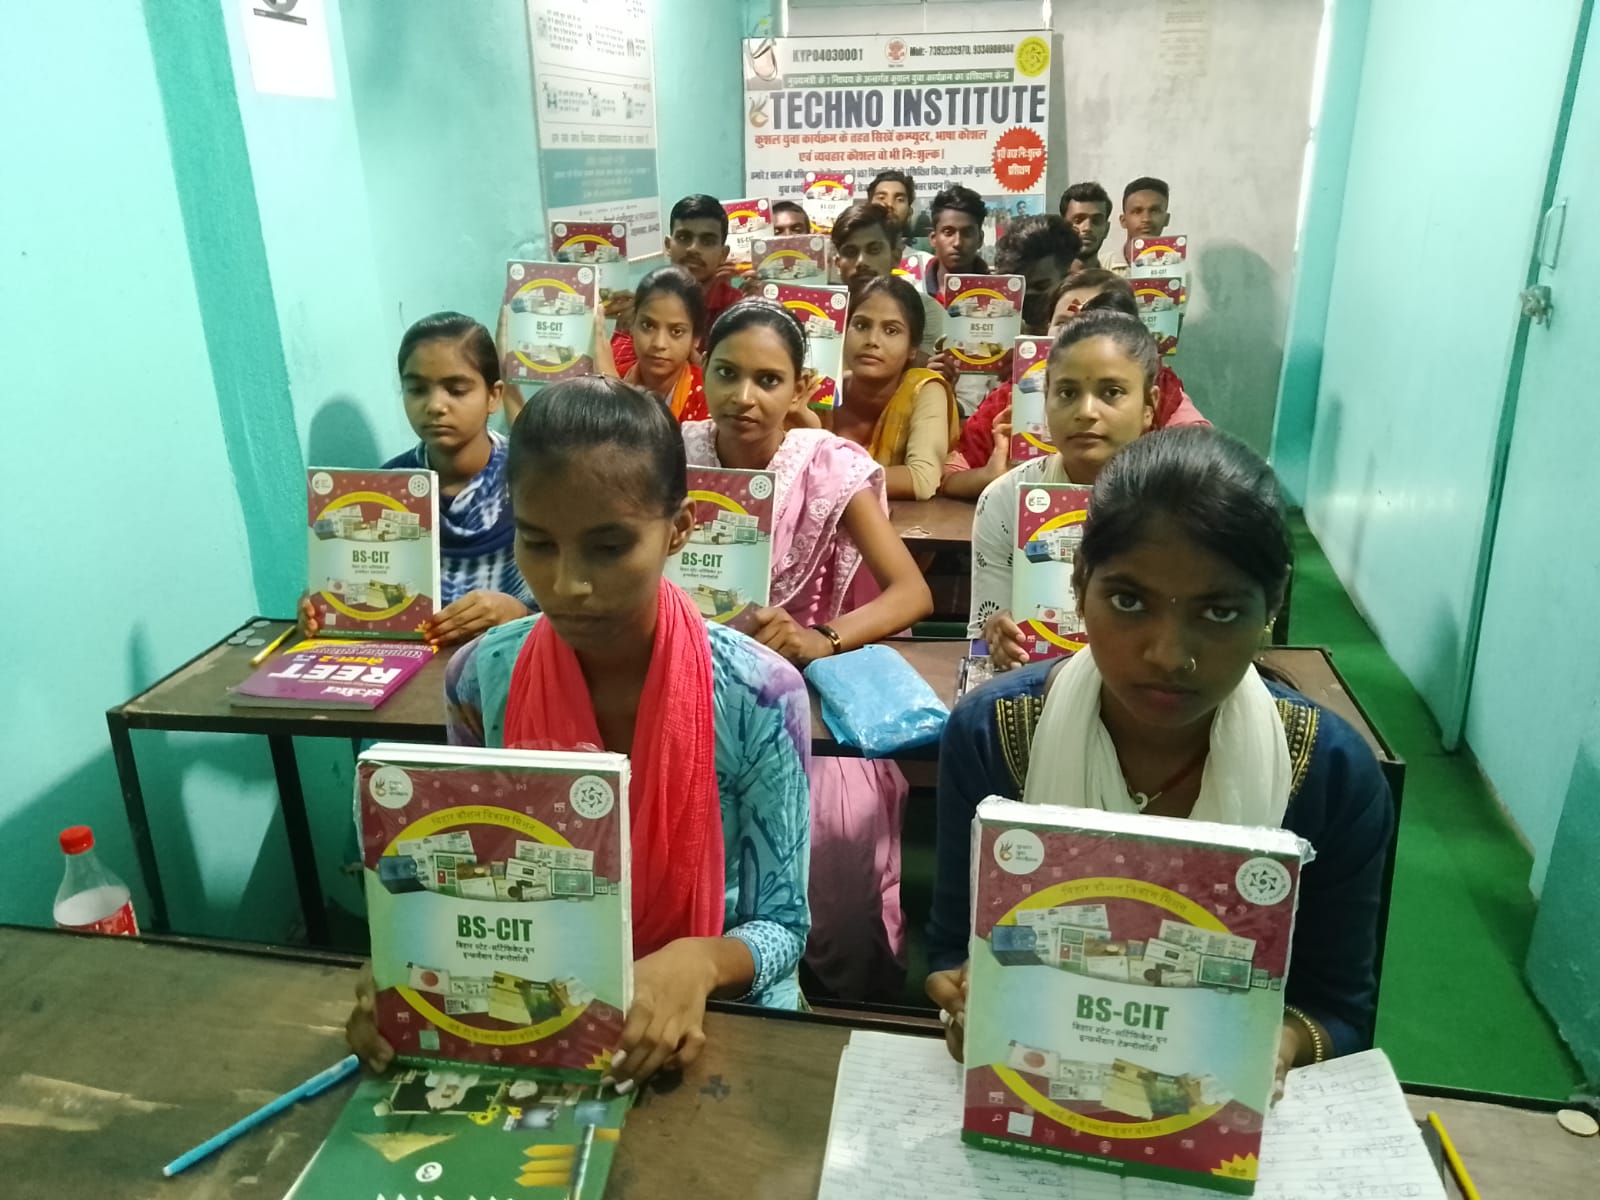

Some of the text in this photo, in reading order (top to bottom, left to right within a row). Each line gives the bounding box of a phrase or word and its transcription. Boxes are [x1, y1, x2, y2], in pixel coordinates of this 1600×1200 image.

[769, 85, 1046, 130] TECHNO INSTITUTE
[754, 134, 781, 148] कुशल
[782, 133, 800, 148] युवा
[802, 131, 837, 144] कार्यक्रम
[839, 131, 848, 143] के
[850, 132, 870, 143] तहत
[935, 130, 956, 141] भाषा
[889, 148, 900, 160] भी
[536, 320, 563, 332] BS-CIT
[970, 323, 994, 331] BS-CIT
[352, 550, 390, 563] BS-CIT
[681, 551, 723, 568] BS-CIT
[268, 662, 402, 685] REET
[456, 914, 533, 943] BS-CIT
[1076, 994, 1170, 1031] BS-CIT
